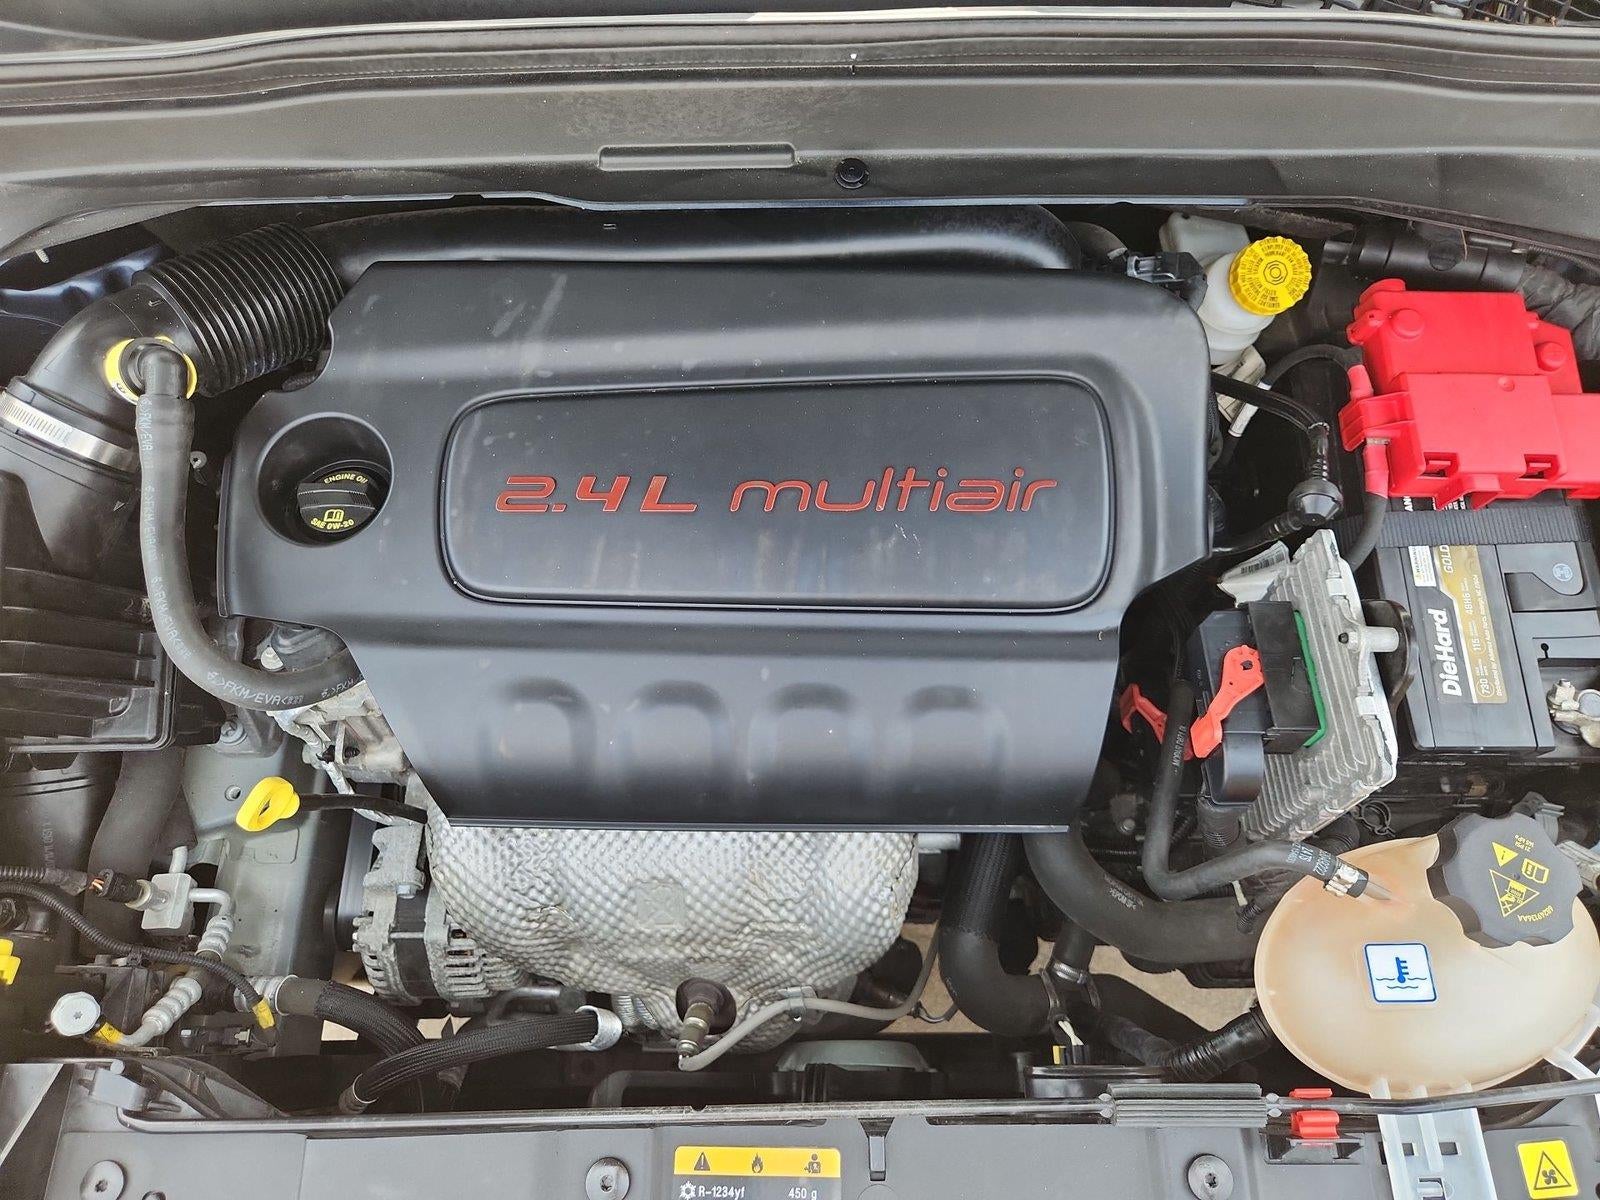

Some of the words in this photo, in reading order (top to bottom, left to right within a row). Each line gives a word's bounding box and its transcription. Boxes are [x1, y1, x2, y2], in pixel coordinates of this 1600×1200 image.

[323, 473, 356, 484] ENGINE
[729, 466, 1058, 513] multiair
[310, 517, 326, 529] SAE
[326, 519, 355, 530] 0W-20
[1439, 545, 1454, 573] GOLD
[1427, 608, 1462, 697] DieHard
[1480, 677, 1491, 695] 730
[698, 1184, 746, 1200] R-1234yf
[788, 1187, 807, 1199] 450
[810, 1189, 818, 1200] g
